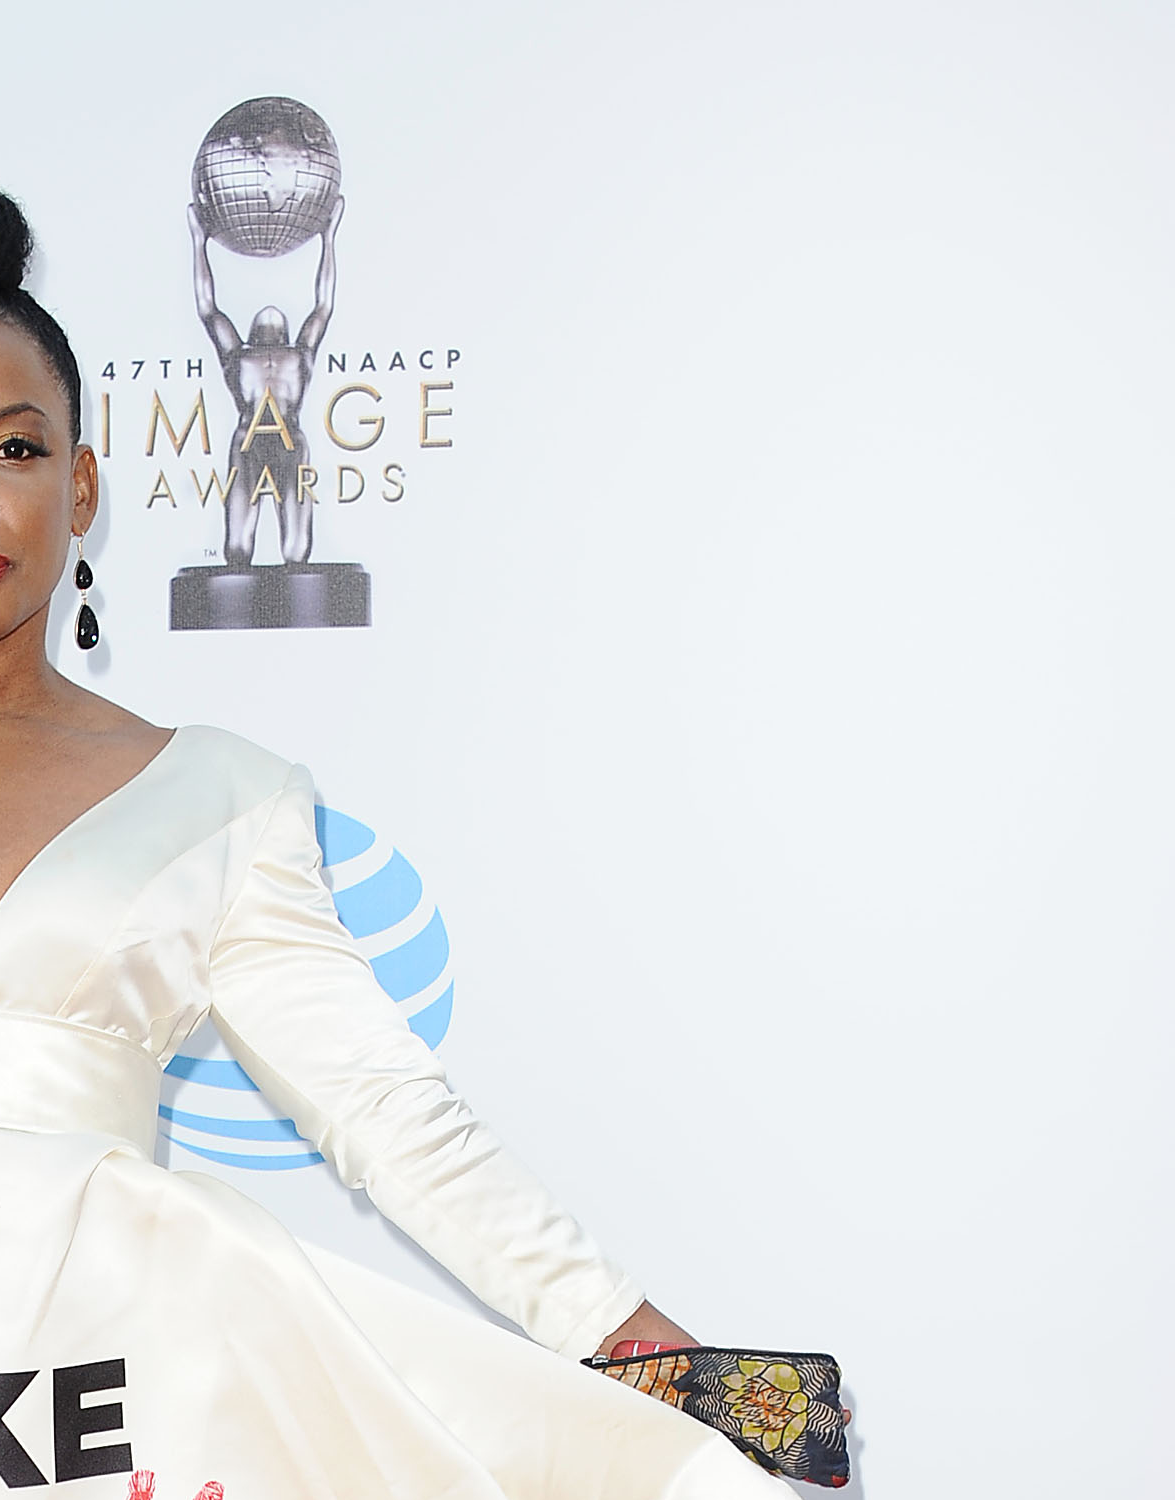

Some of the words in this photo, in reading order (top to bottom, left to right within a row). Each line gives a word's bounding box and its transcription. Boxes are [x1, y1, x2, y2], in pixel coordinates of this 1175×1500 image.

[101, 357, 204, 381] 47TH
[327, 348, 462, 374] NAACP
[100, 381, 455, 459] IMAGE
[146, 463, 407, 508] AWARDS
